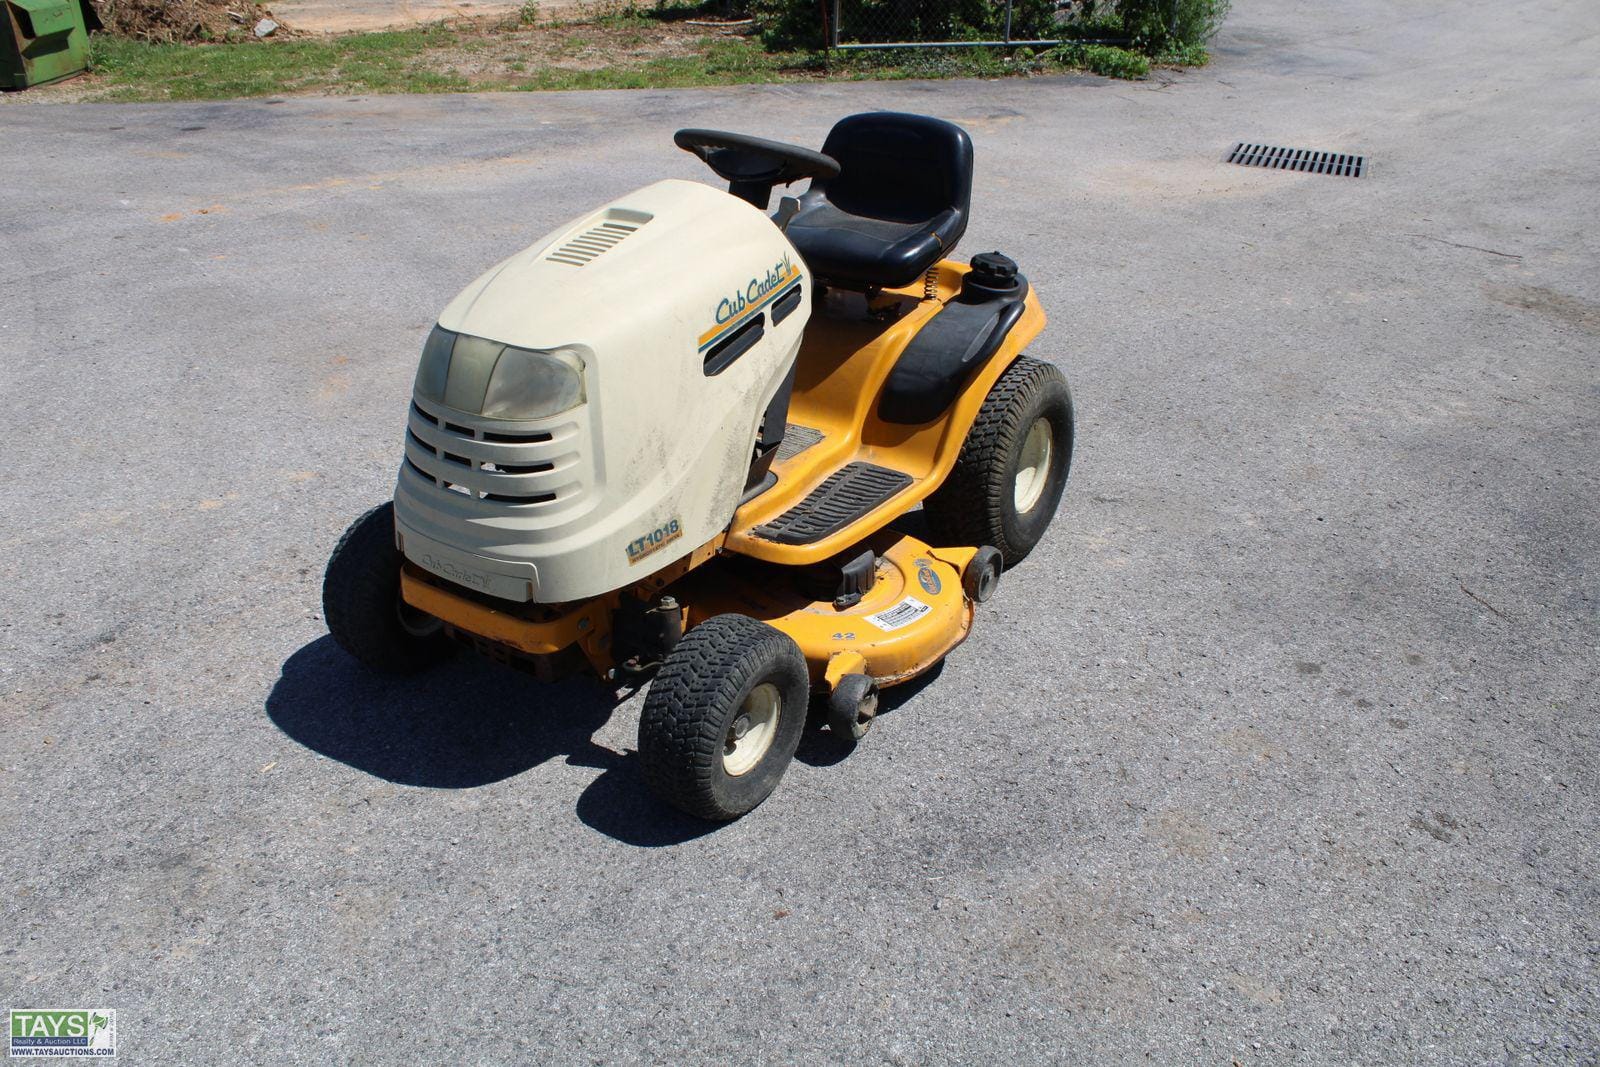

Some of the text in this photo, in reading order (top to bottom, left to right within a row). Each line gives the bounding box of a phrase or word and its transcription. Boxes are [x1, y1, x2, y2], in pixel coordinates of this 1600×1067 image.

[716, 262, 785, 325] Cub Cadet
[626, 519, 679, 557] LT1018
